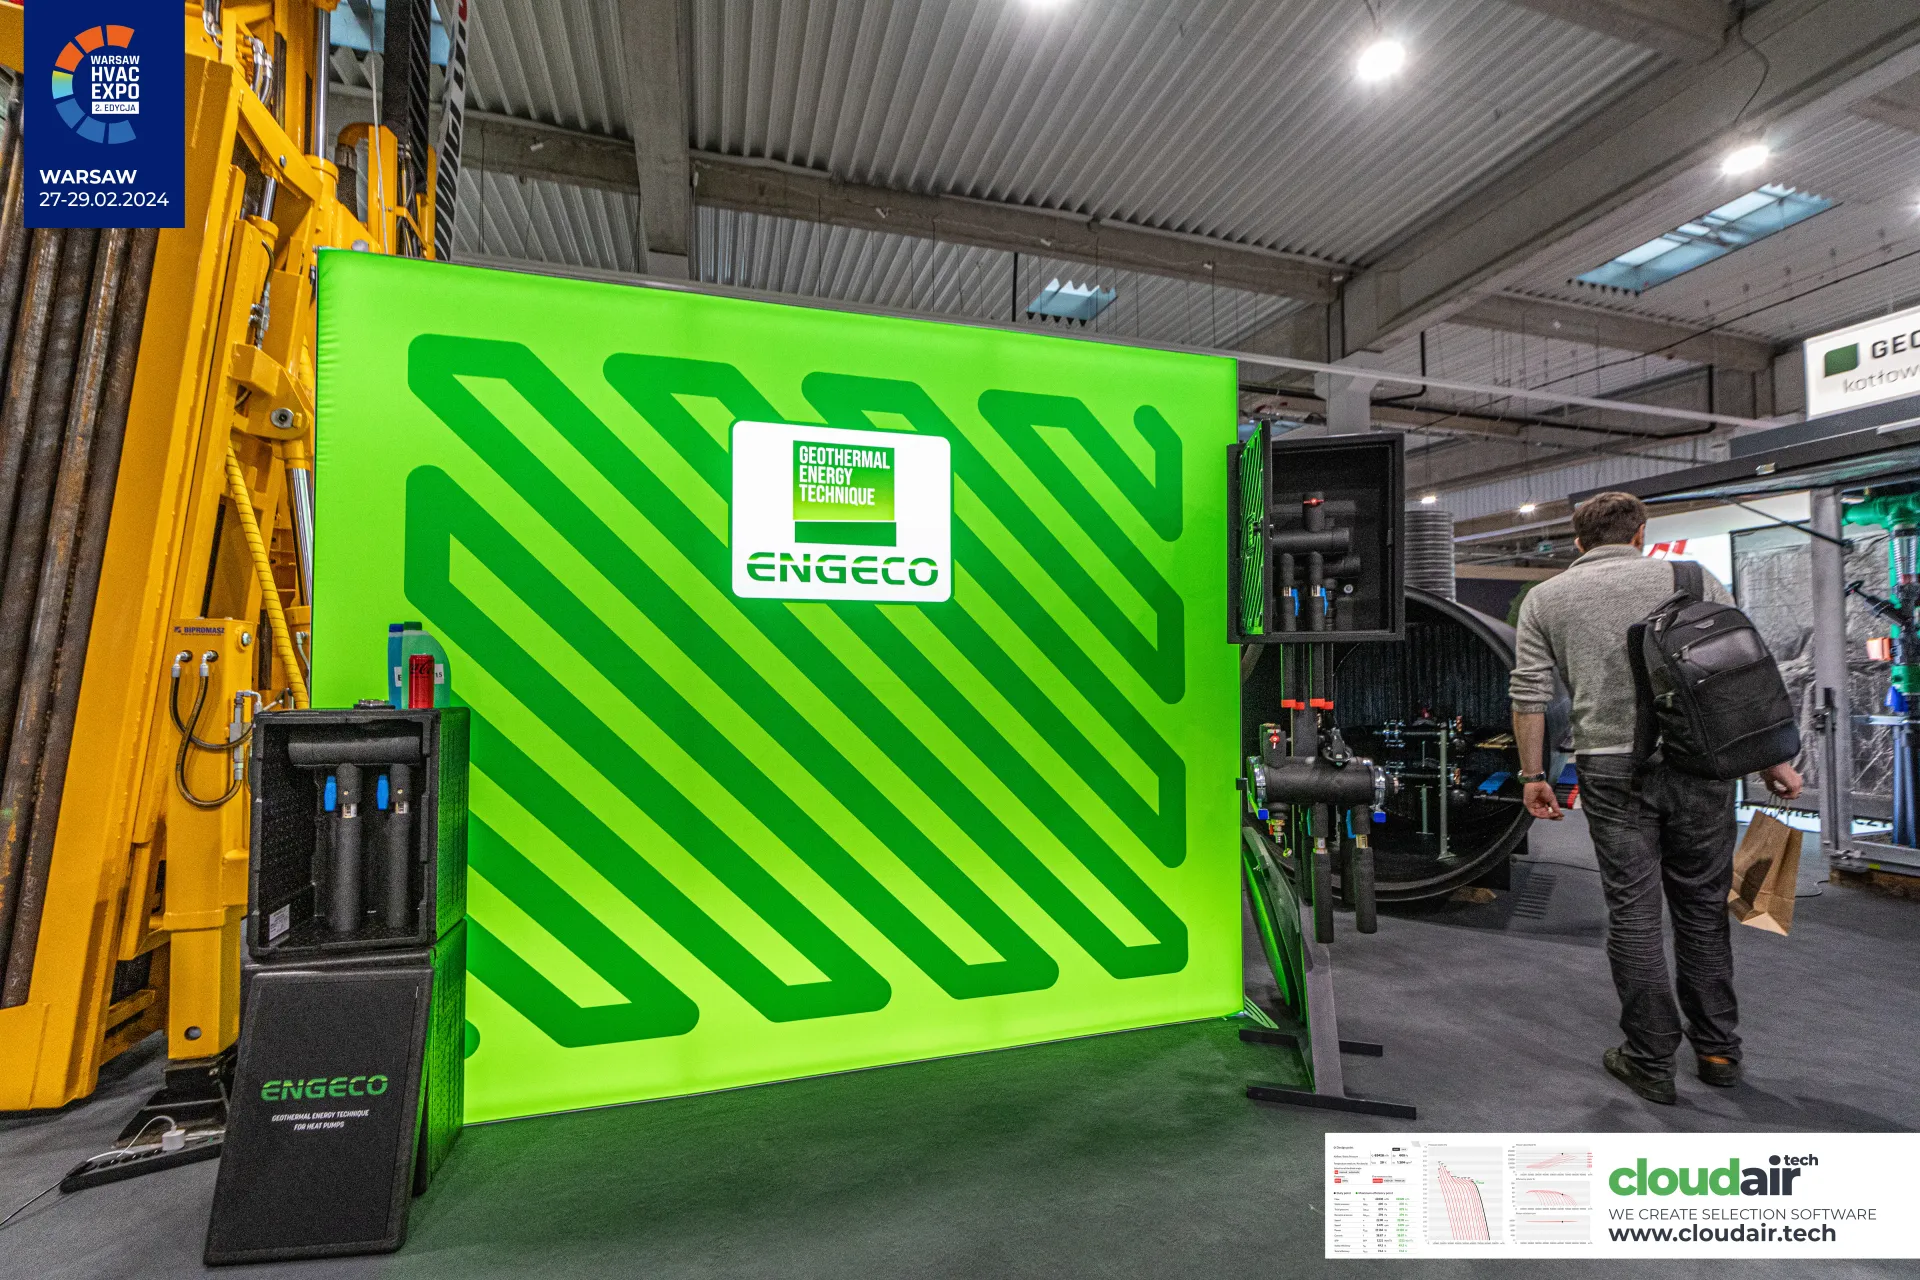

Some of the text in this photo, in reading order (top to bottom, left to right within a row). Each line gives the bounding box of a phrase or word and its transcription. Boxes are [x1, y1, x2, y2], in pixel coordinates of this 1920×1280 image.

[798, 445, 891, 470] GEOTHERMAL
[798, 464, 854, 486] ENERGY
[798, 483, 876, 506] TECHNIQUE
[746, 551, 939, 587] ENGECO
[260, 1074, 389, 1101] ENGECO
[271, 1109, 370, 1122] GEOTHERMAL ENERGY TECHNIQUE
[293, 1121, 345, 1131] FOR HEAT PUMPS
